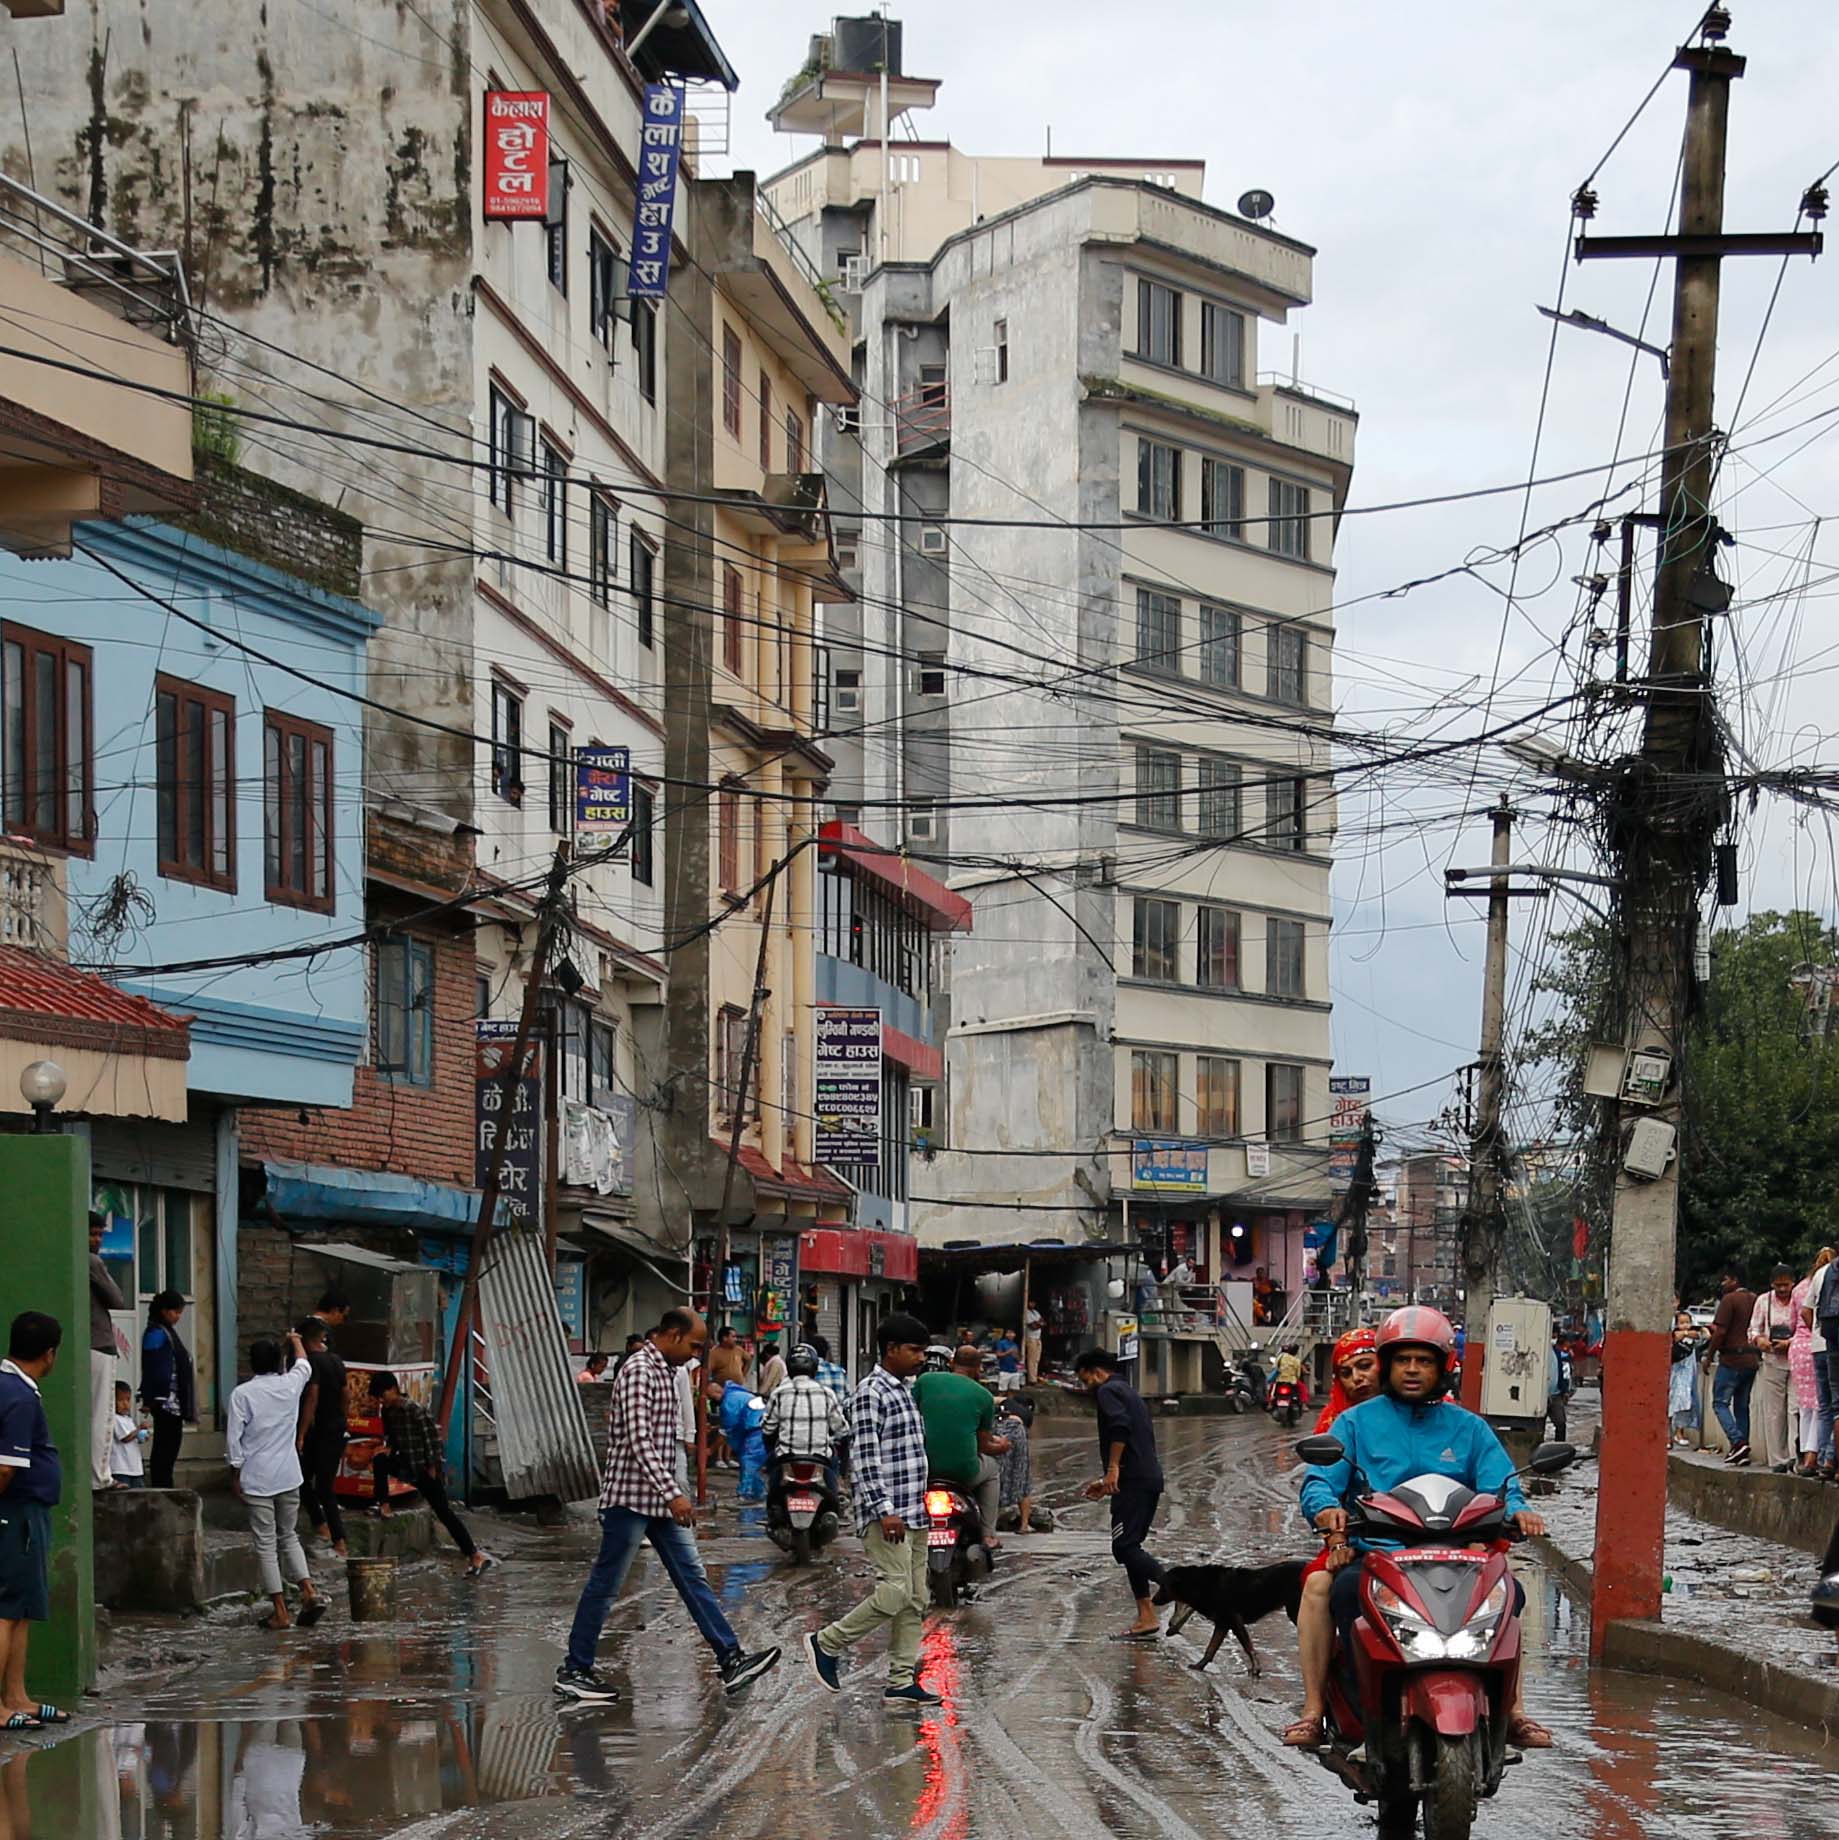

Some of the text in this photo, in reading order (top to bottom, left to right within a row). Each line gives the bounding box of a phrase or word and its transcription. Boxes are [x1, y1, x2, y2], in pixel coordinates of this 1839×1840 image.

[491, 96, 543, 118] कैलाश
[497, 121, 536, 194] होटल
[590, 785, 621, 802] गेष्ट
[585, 806, 626, 820] हाउस
[846, 1045, 879, 1058] हाउस
